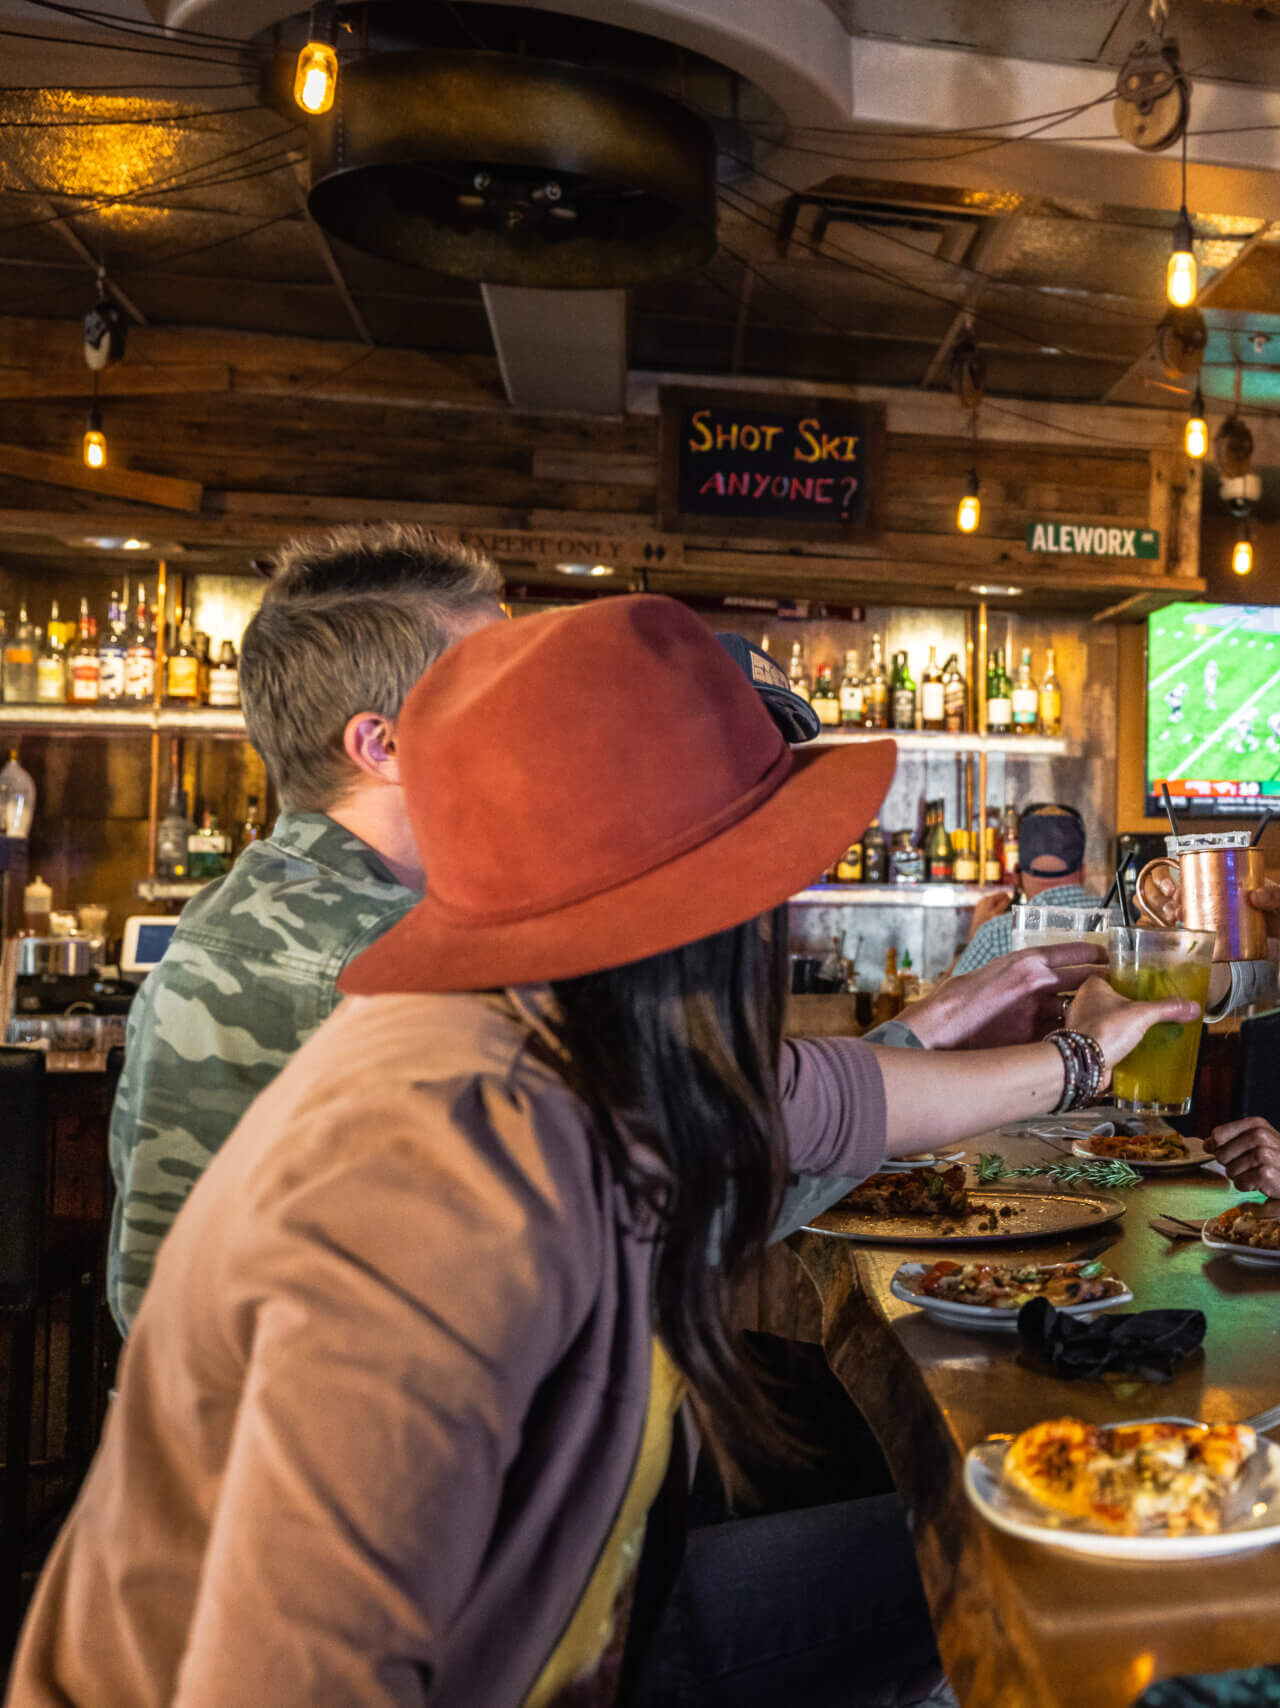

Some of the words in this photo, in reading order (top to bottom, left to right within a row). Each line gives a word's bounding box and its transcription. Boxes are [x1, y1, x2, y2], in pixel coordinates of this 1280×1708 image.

[699, 471, 859, 520] ANYONE?
[556, 537, 626, 559] ONLY
[1031, 523, 1137, 557] ALEWORX
